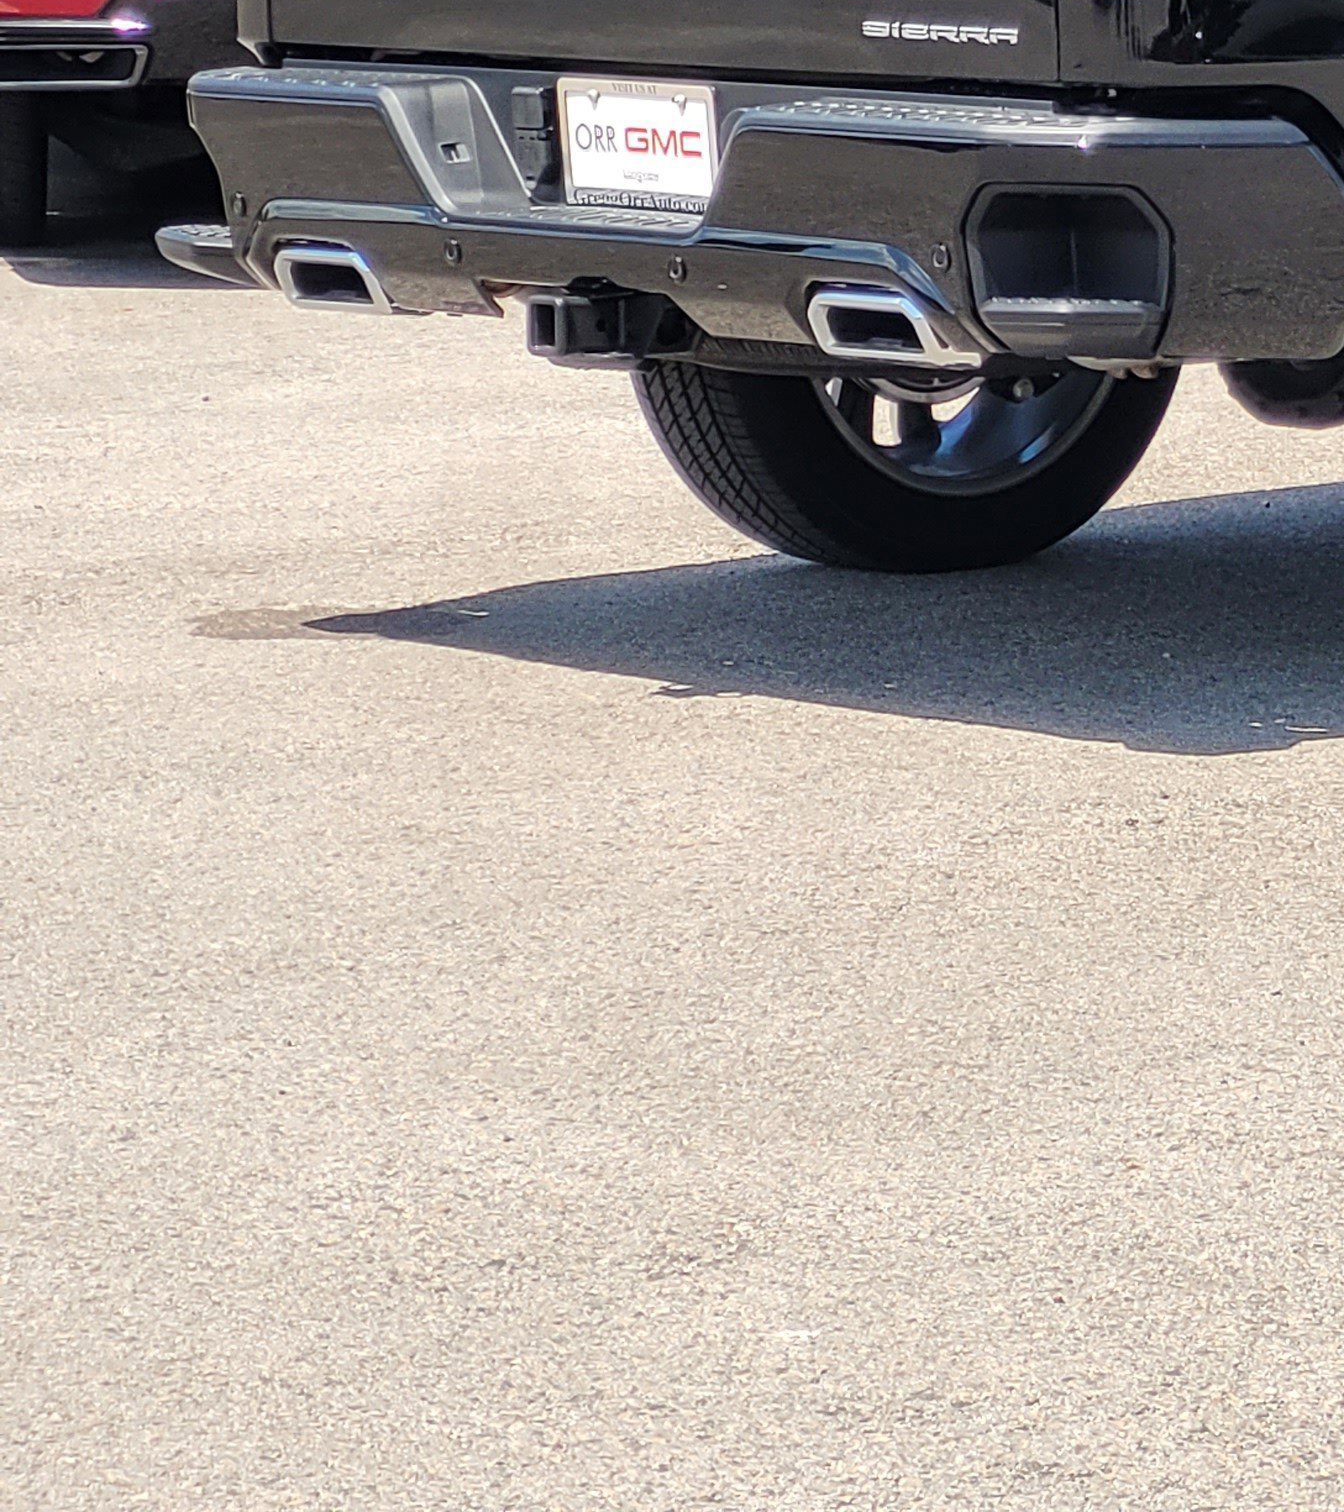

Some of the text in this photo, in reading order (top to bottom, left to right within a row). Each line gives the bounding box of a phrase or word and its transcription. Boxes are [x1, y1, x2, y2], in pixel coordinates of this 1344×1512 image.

[861, 20, 1019, 46] SIERRA
[575, 123, 702, 158] ORR GMC
